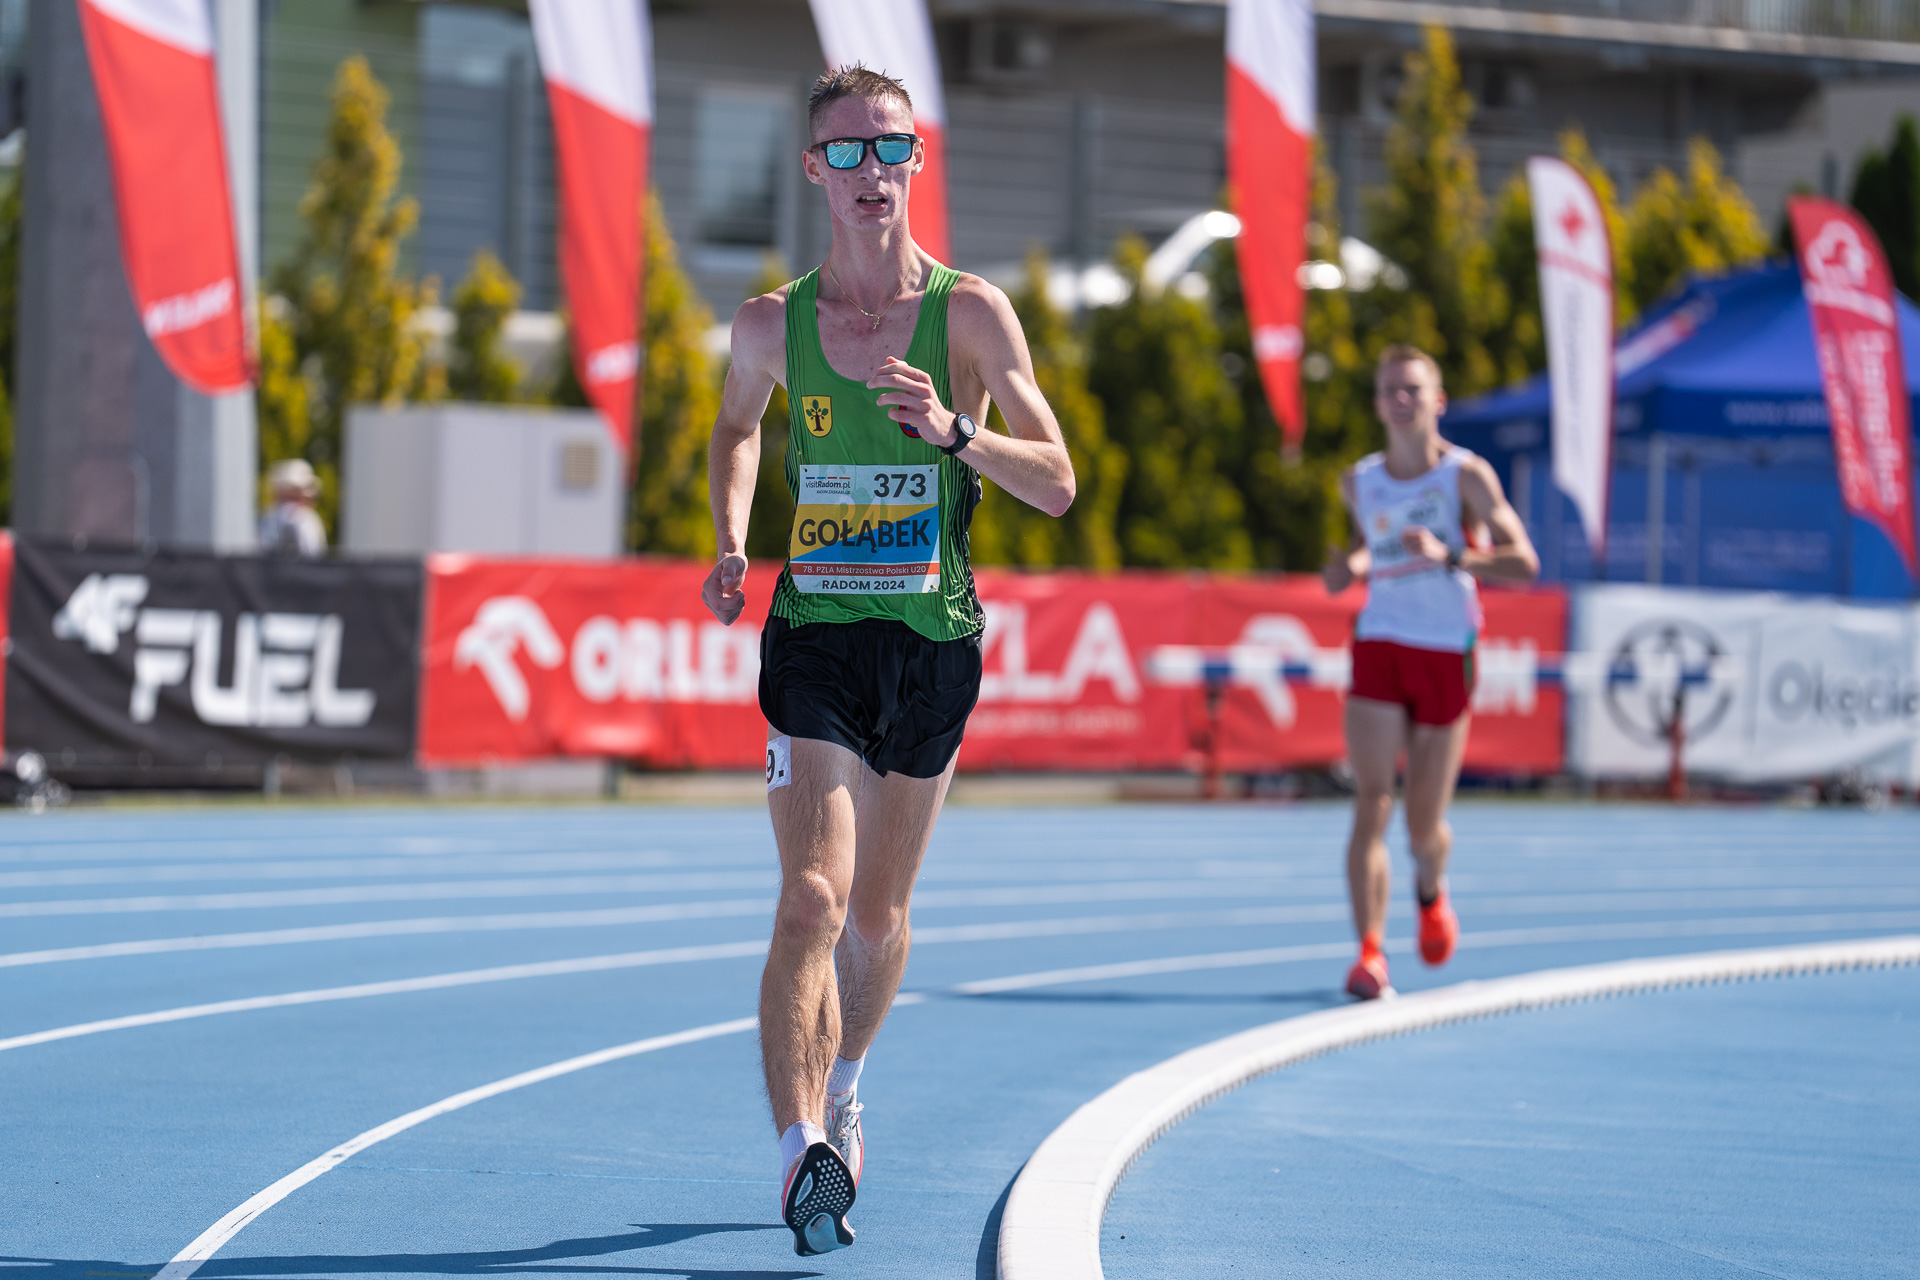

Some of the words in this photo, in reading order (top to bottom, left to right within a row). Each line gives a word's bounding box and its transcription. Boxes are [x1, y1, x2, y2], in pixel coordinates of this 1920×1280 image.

[805, 480, 851, 490] visitRadom.pl
[873, 473, 927, 498] 373
[798, 518, 932, 554] GOŁĄBEK
[802, 565, 815, 574] 78.
[816, 566, 835, 575] PZLA
[836, 565, 885, 576] Mistrzostwa
[886, 566, 909, 576] Polski
[910, 565, 928, 574] U20
[822, 579, 871, 591] RADOM
[873, 579, 906, 591] 2024
[129, 608, 377, 728] FUEL
